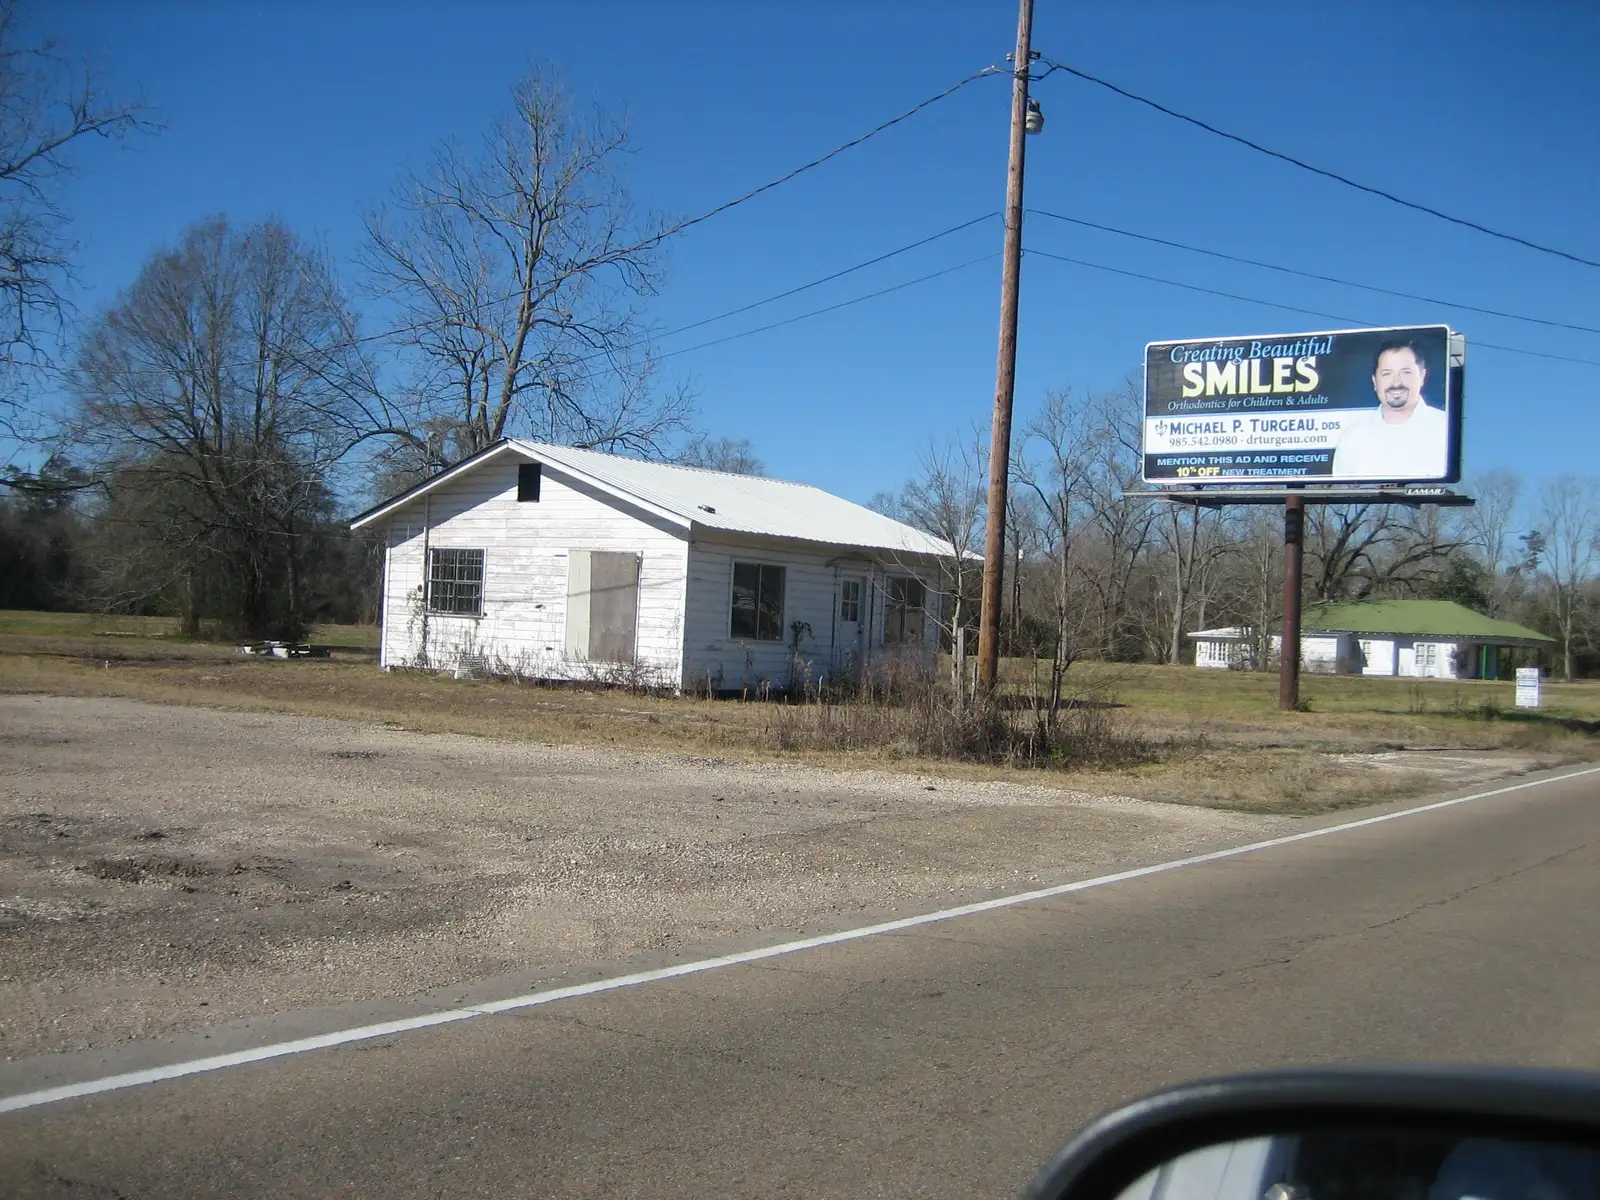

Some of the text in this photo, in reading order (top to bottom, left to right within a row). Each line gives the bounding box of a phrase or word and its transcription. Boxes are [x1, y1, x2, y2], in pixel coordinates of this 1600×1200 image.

[1170, 336, 1334, 365] Creating Beautiful
[1182, 356, 1320, 398] SMILES
[1168, 394, 1329, 411] Orthodontics for Children & Adults
[1170, 421, 1226, 436] MICHAEL
[1232, 420, 1244, 433] P.
[1322, 421, 1340, 430] DDS
[1169, 434, 1328, 448] 985.542.0980 drturgeau.com
[1157, 454, 1328, 466] MENTION THIS AD AND RECEIVE
[1196, 467, 1220, 476] OFF
[1222, 468, 1244, 476] NEW
[1247, 468, 1307, 476] TREATMENT
[1408, 488, 1442, 496] LAMAR
